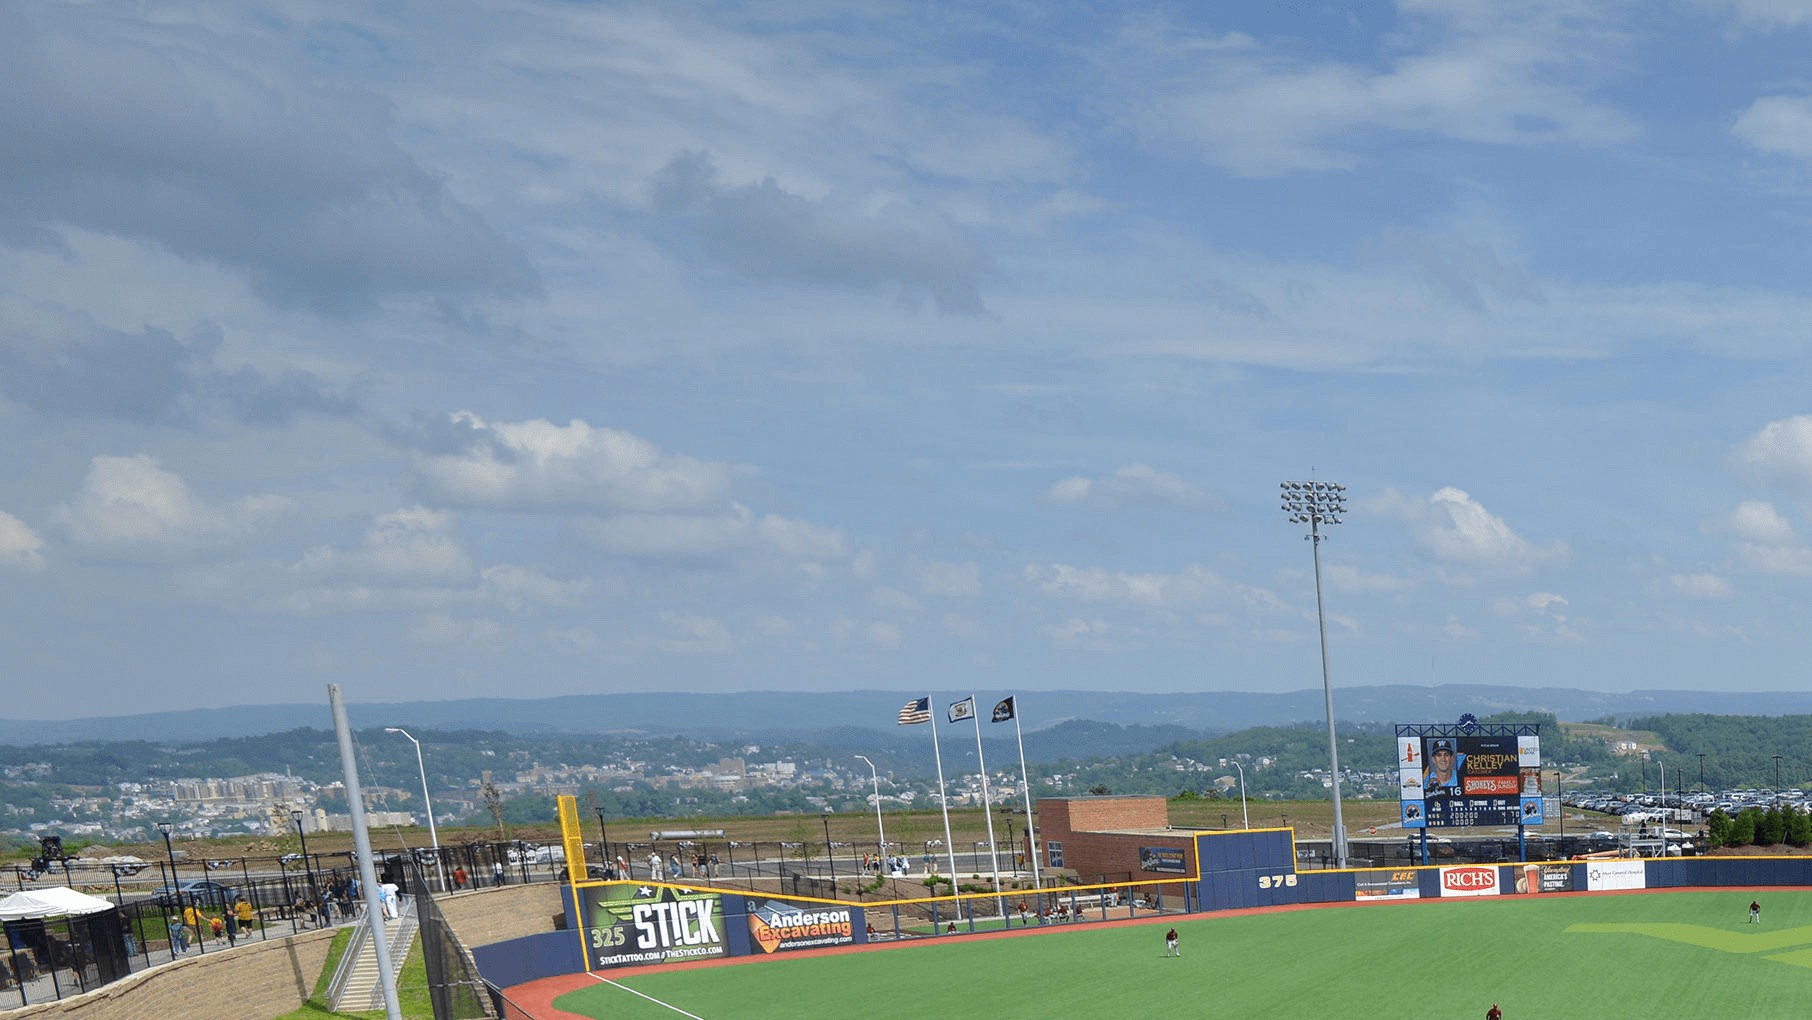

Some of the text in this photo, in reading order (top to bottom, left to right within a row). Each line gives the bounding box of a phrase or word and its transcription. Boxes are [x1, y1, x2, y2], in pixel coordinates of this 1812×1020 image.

[1450, 787, 1461, 796] 16
[1259, 874, 1297, 888] 375
[1446, 872, 1493, 887] RICH'S
[770, 910, 850, 928] Anderson
[591, 927, 626, 948] 325
[760, 922, 852, 942] Excavating
[780, 936, 852, 948] andersonexcavating.com
